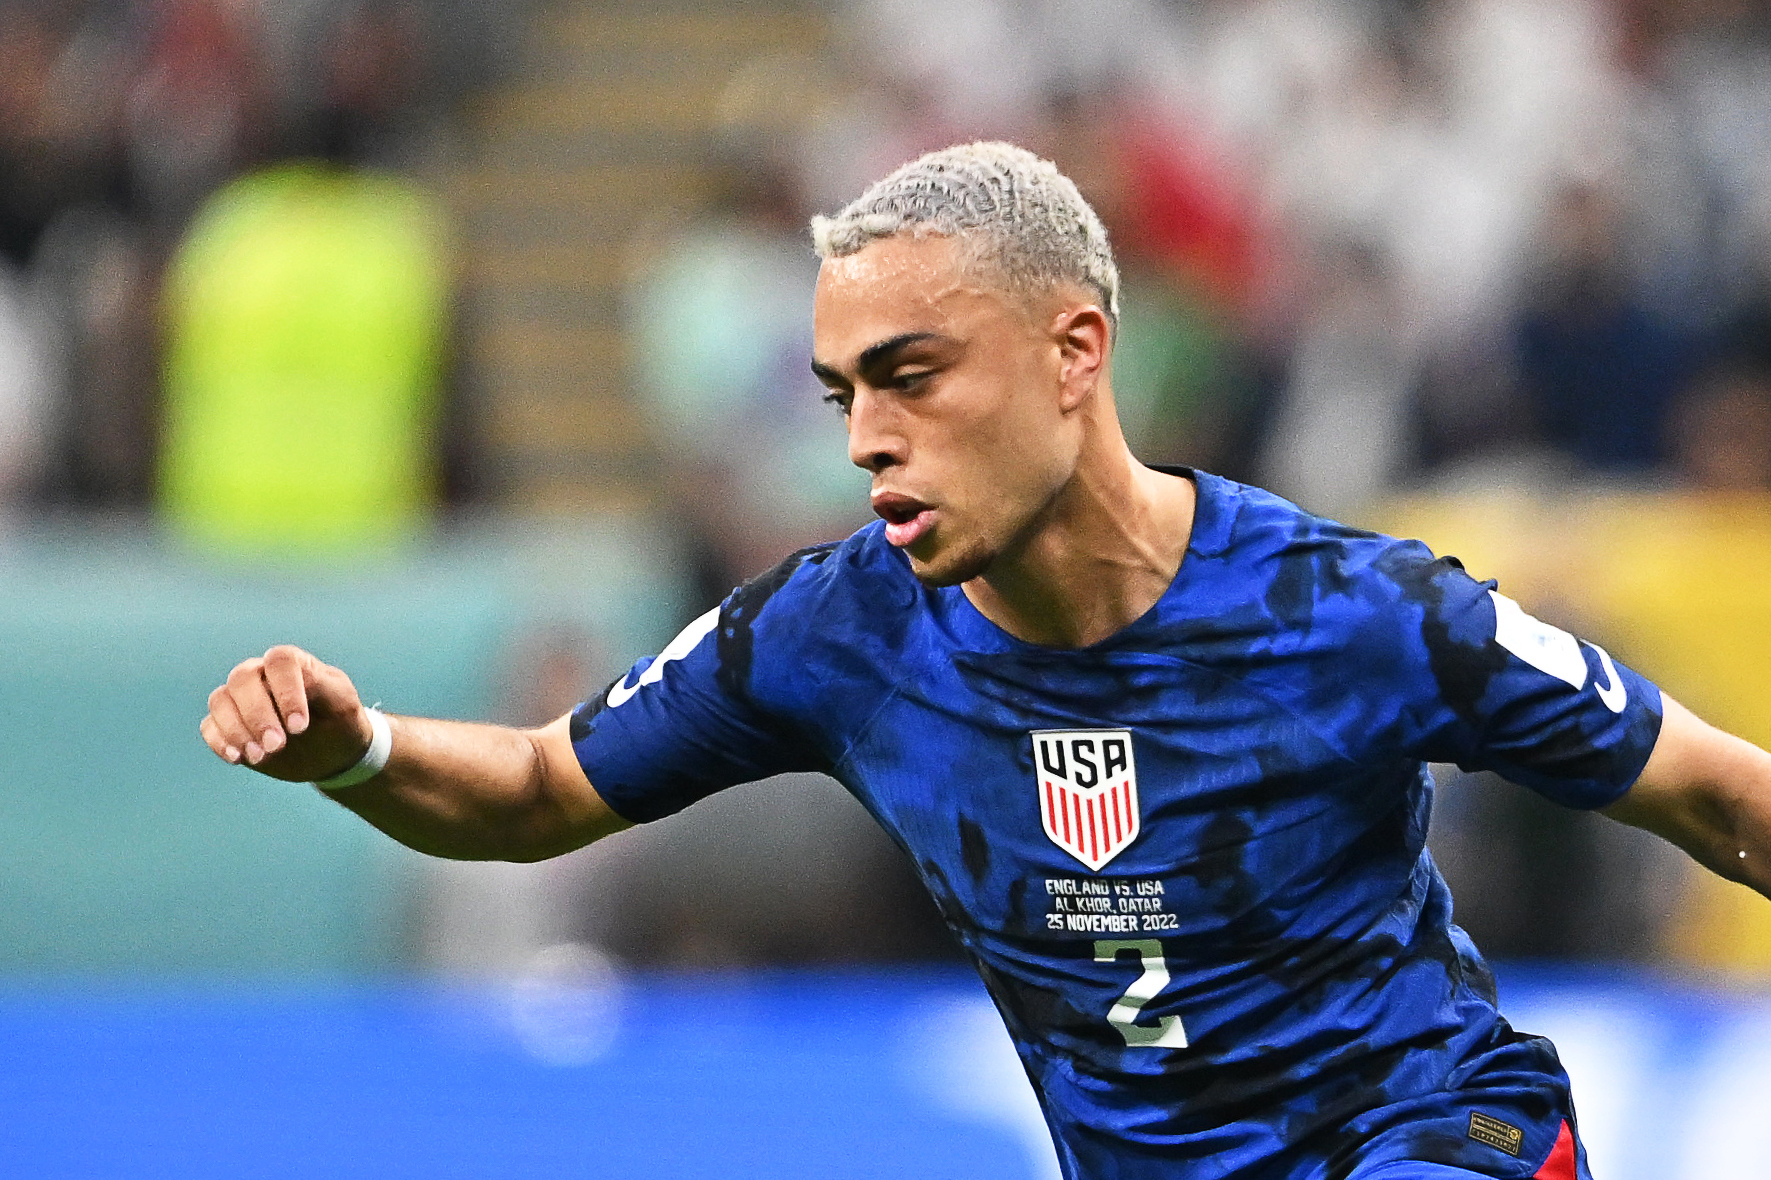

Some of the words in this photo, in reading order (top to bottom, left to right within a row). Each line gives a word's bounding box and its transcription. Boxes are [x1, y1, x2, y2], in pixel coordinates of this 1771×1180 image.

[1039, 738, 1128, 789] USA
[1045, 878, 1110, 895] ENGLAND
[1113, 880, 1134, 896] VS.
[1136, 880, 1165, 896] USA
[1055, 897, 1074, 912] AL
[1075, 897, 1117, 914] KHOR,
[1118, 897, 1162, 913] QATAR
[1045, 913, 1064, 929] 25
[1066, 914, 1138, 932] NOVEMBER
[1141, 913, 1179, 931] 2022
[1094, 938, 1188, 1049] 2
